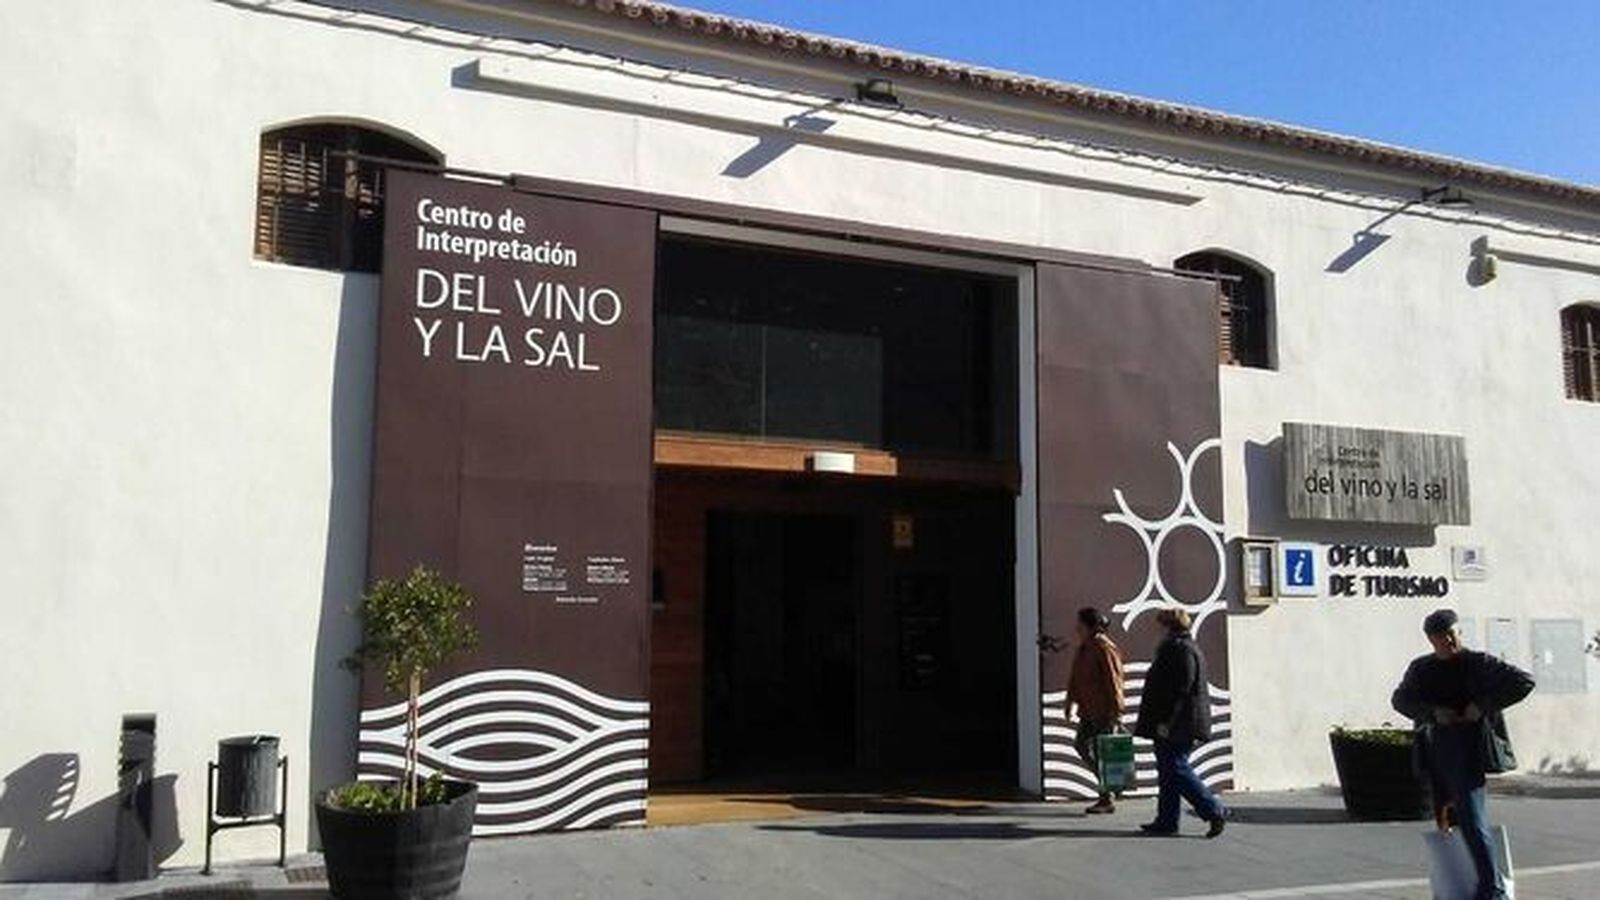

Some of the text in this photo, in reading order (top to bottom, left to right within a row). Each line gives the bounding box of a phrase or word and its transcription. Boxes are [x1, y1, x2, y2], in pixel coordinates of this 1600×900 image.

[417, 199, 526, 233] Centro de
[417, 225, 577, 267] Interpretación
[416, 268, 621, 325] DEL VINO
[414, 317, 600, 371] Y LA SAL
[1304, 470, 1448, 503] del vino y la sal
[1327, 543, 1410, 569] OFICINA
[1328, 573, 1449, 598] DE TURISMO
